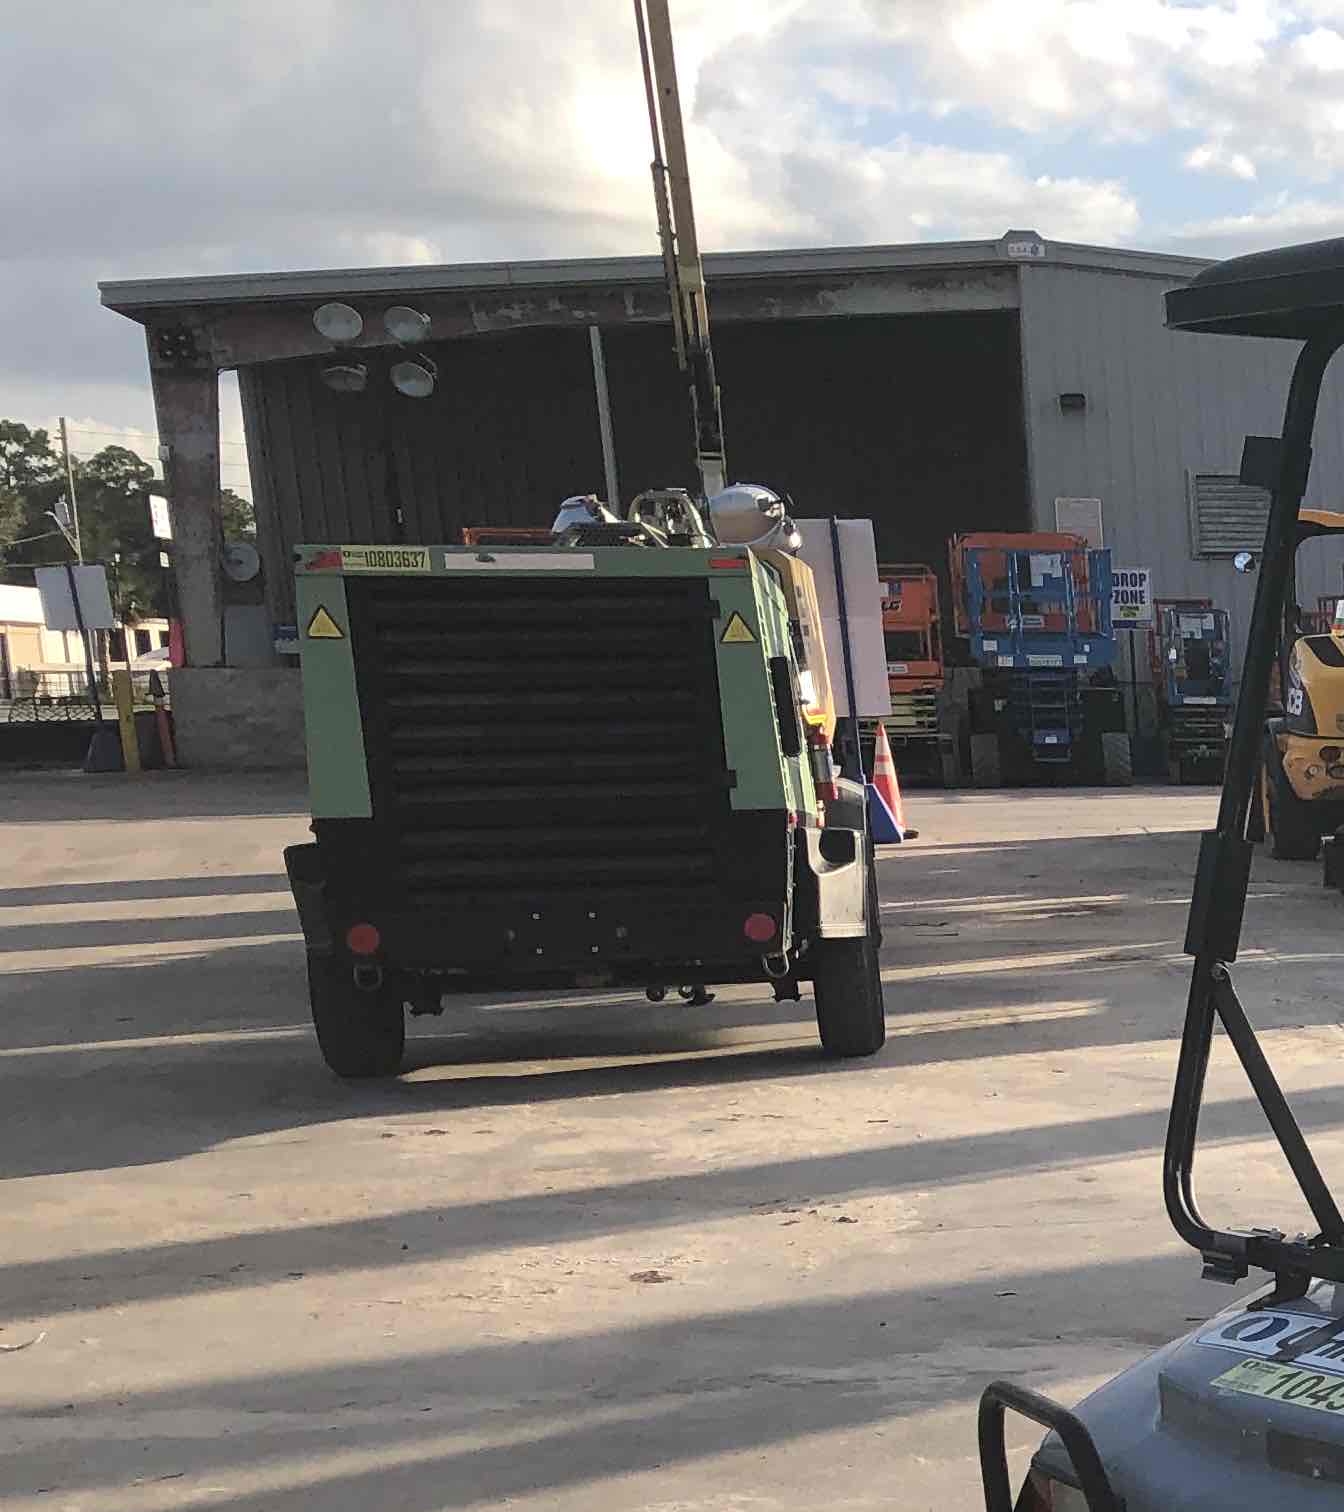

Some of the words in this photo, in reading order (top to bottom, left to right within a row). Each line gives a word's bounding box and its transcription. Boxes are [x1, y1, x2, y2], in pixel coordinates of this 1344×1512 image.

[364, 550, 425, 568] 10803637
[1112, 572, 1147, 588] DROP
[1113, 589, 1146, 605] ZONE
